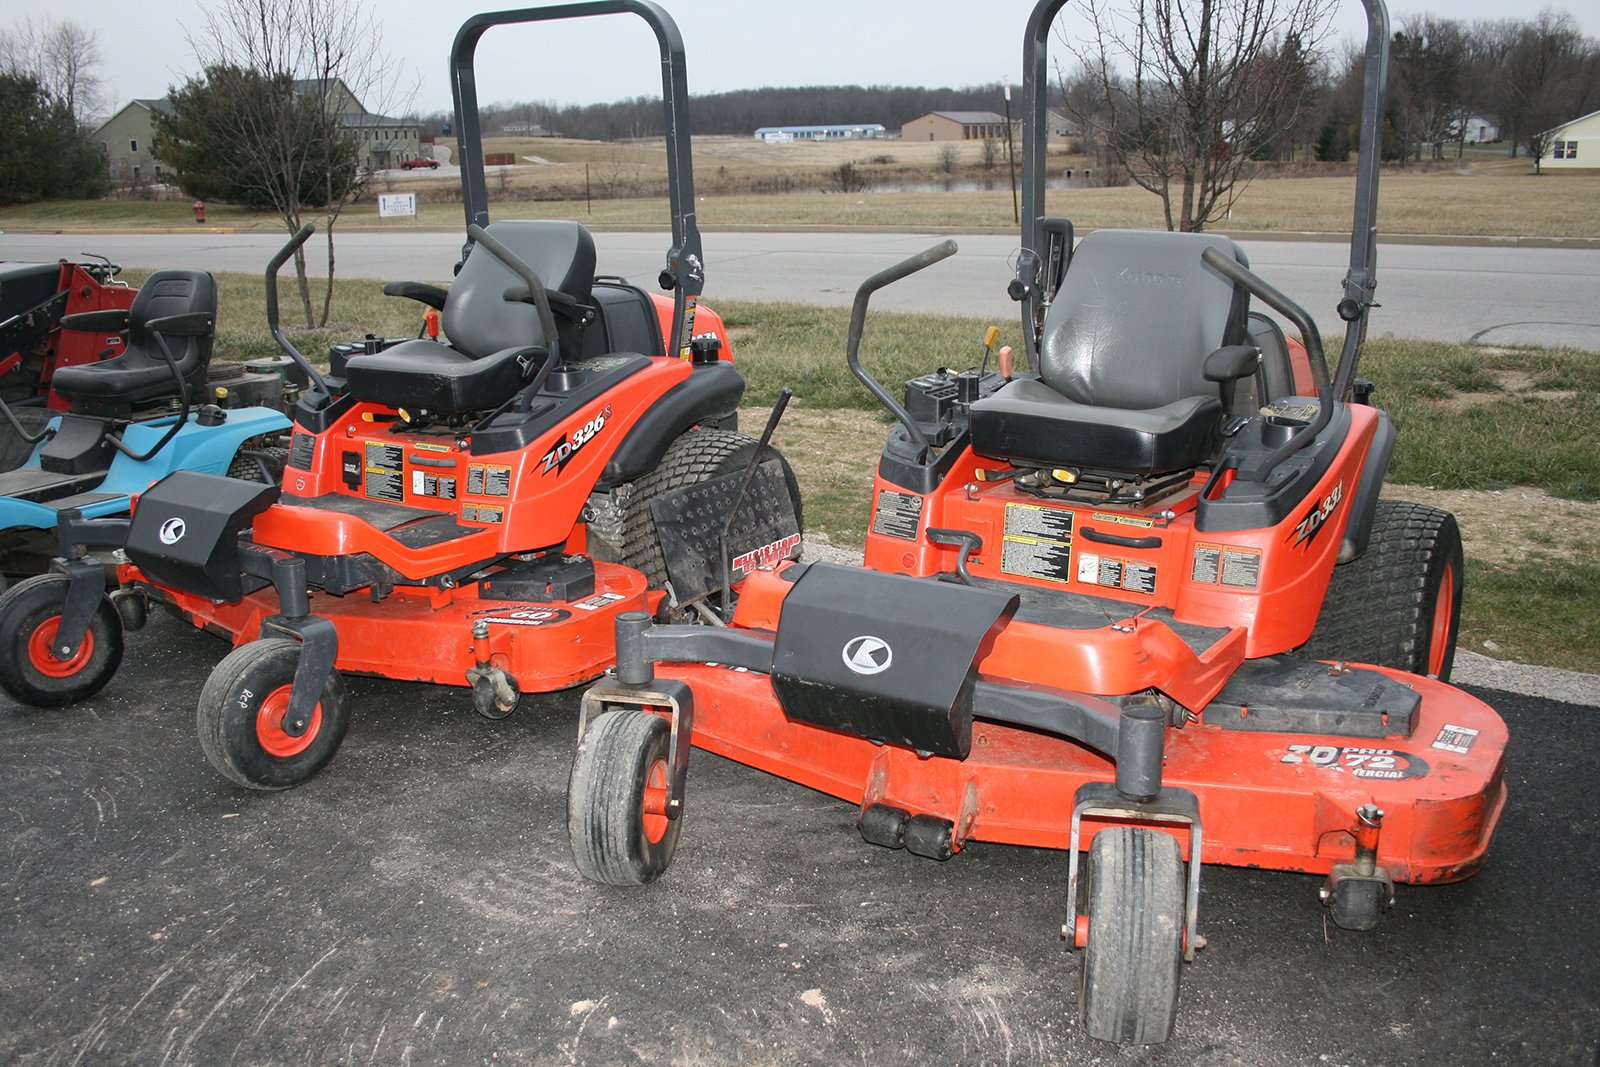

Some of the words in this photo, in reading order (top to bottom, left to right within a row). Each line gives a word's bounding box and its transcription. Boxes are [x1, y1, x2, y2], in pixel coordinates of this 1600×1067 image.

[509, 610, 553, 620] 60
[1342, 747, 1393, 755] PRO
[1344, 754, 1396, 769] 72
